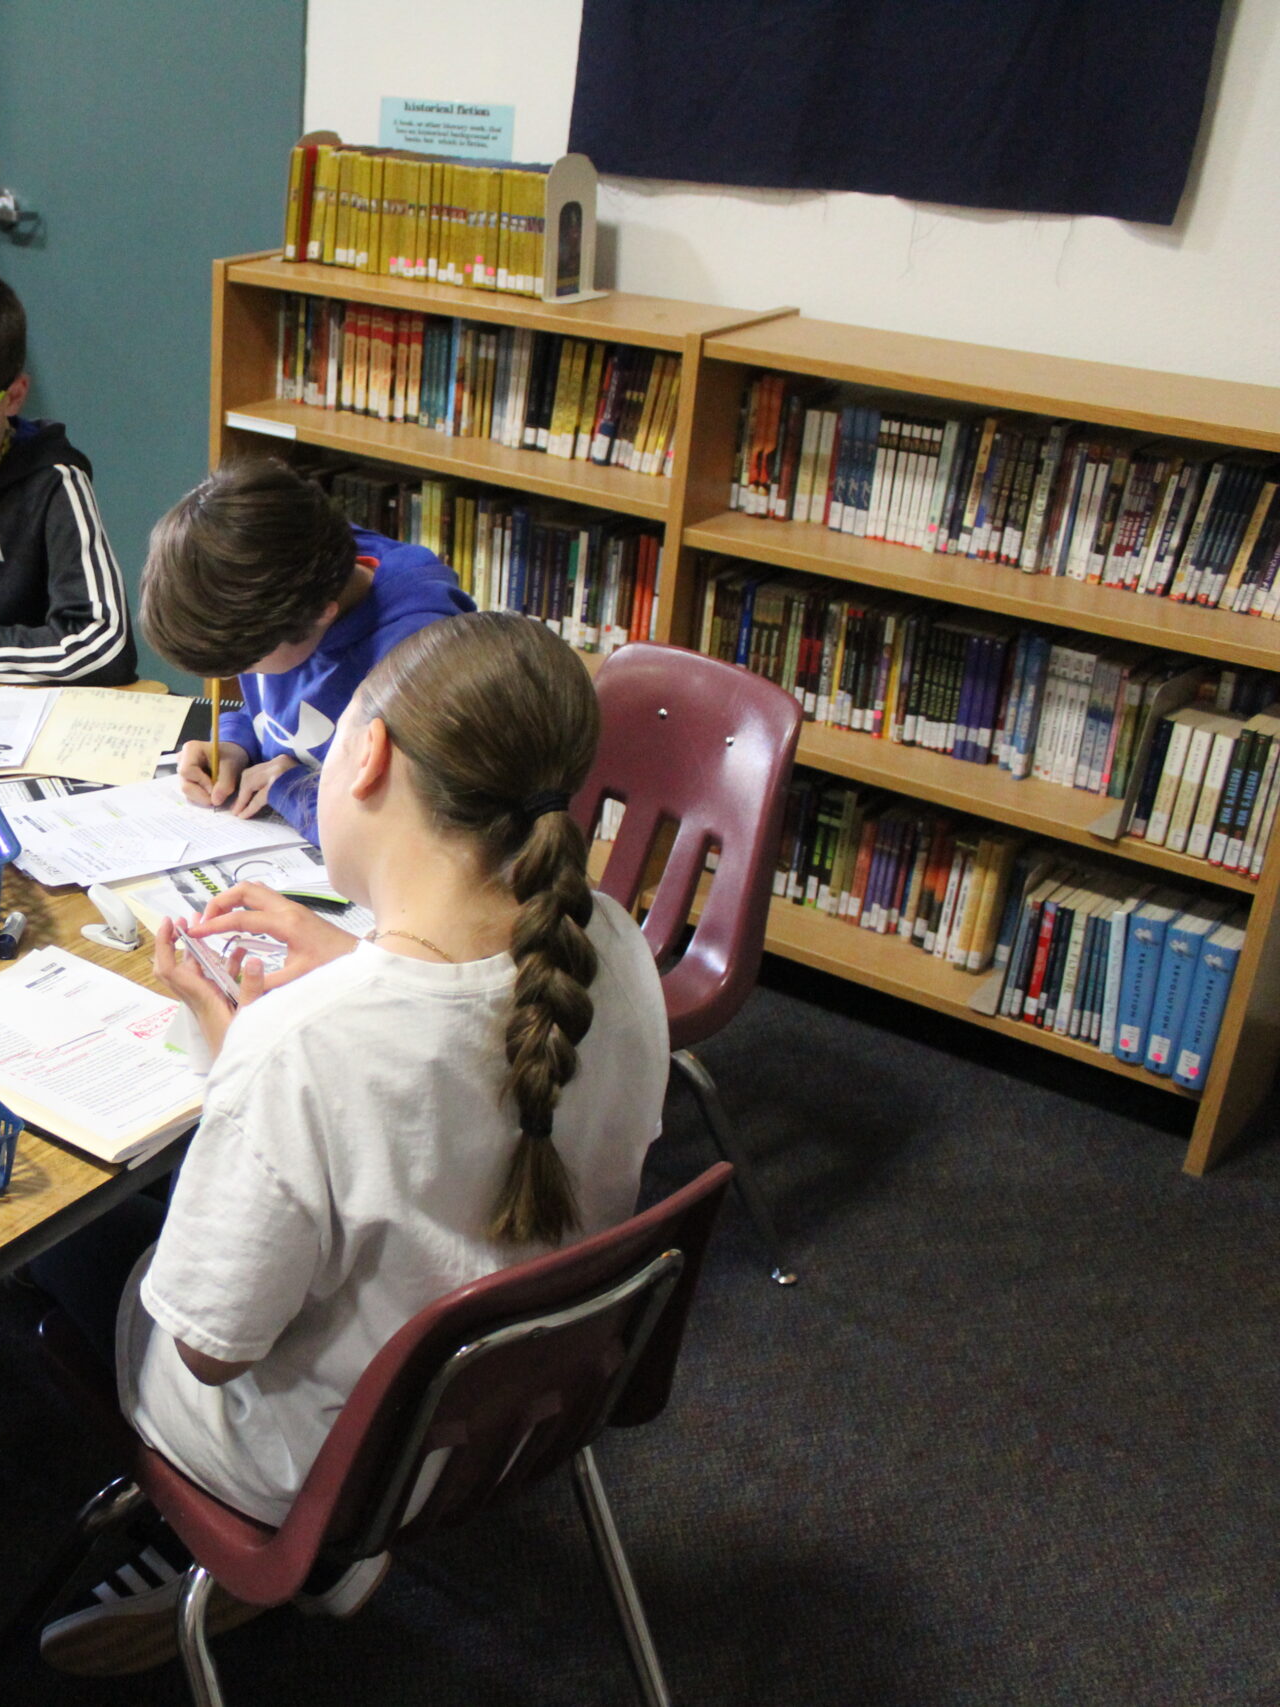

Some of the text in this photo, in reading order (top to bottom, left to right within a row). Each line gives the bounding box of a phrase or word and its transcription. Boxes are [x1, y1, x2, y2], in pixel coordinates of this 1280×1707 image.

[404, 102, 490, 116] historical fiction
[1130, 953, 1146, 1018] REVOLUTION
[1163, 965, 1181, 1029] REVOLUTION
[1194, 979, 1214, 1044] REVOLUTION
